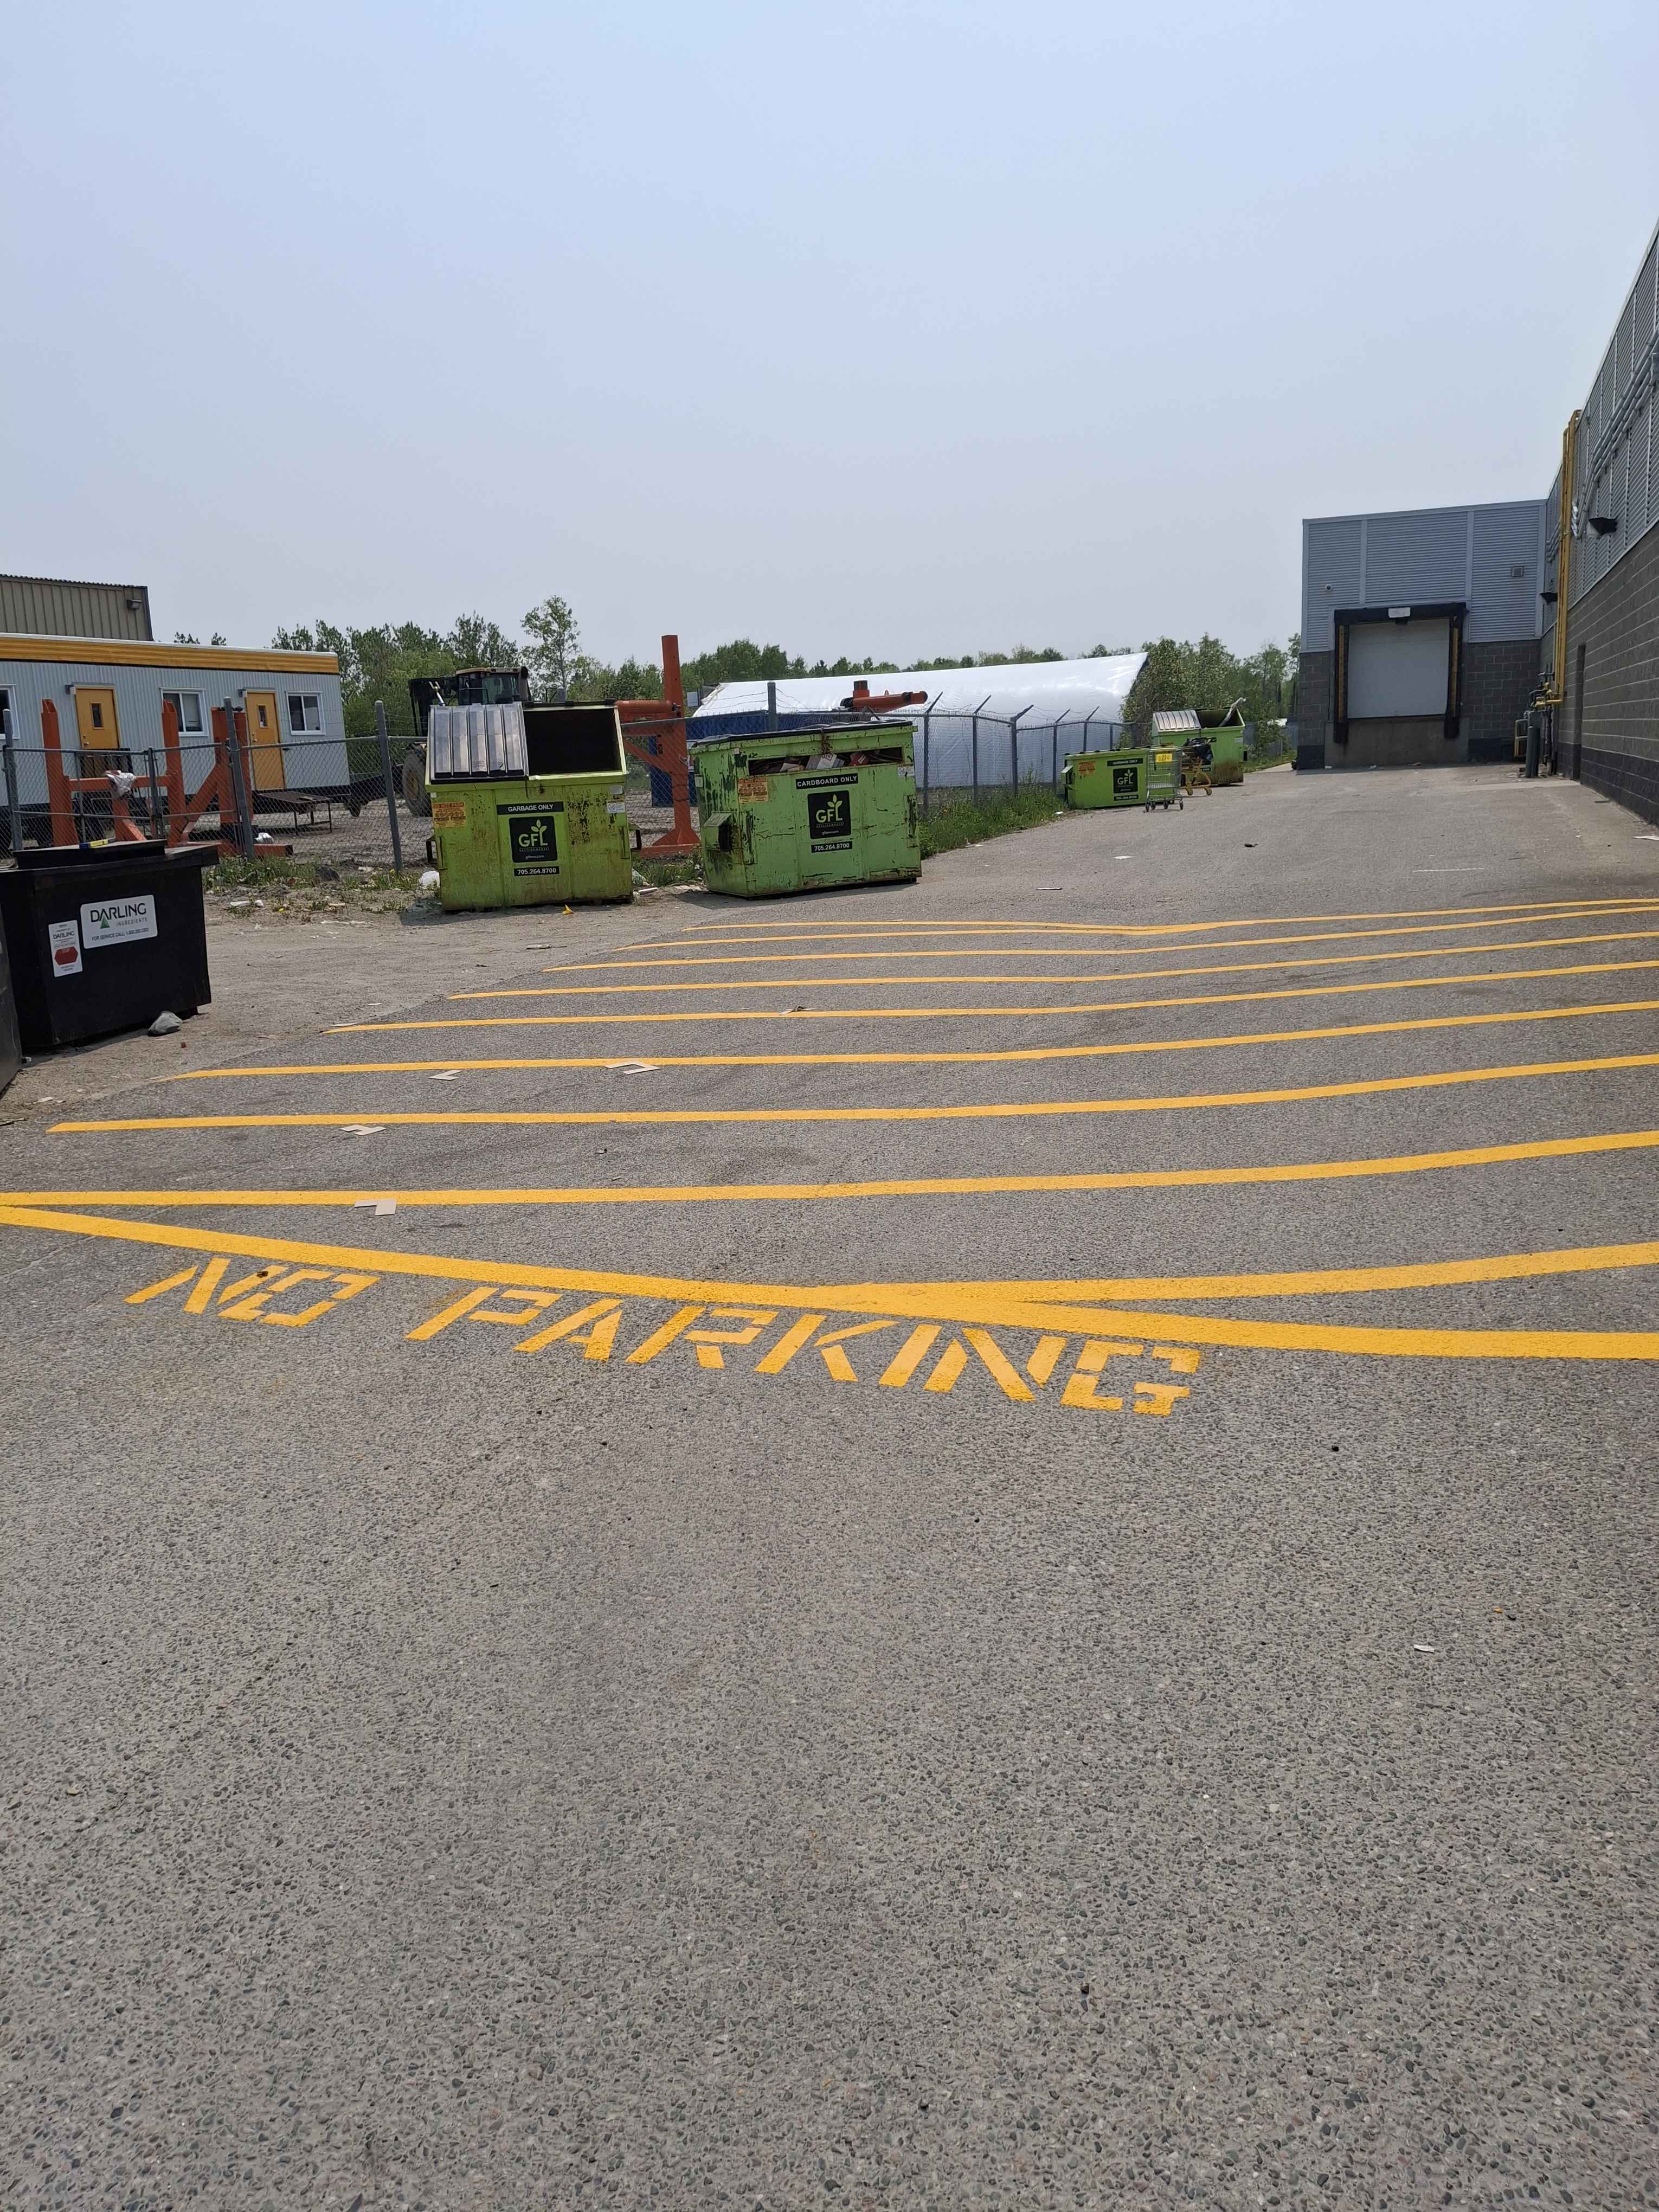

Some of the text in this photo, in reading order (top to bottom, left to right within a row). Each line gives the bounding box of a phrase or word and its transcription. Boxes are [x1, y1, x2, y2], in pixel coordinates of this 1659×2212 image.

[797, 777, 839, 787] CARDBOARD
[1117, 773, 1134, 785] GFL
[815, 801, 843, 823] GFL
[518, 826, 548, 847] GFL
[814, 843, 850, 851] 705.264.8700
[90, 903, 146, 923] DARLING
[116, 917, 148, 927] INGREDIENTS
[53, 930, 75, 940] DARLING
[125, 1258, 1201, 1417] NO PARKING
